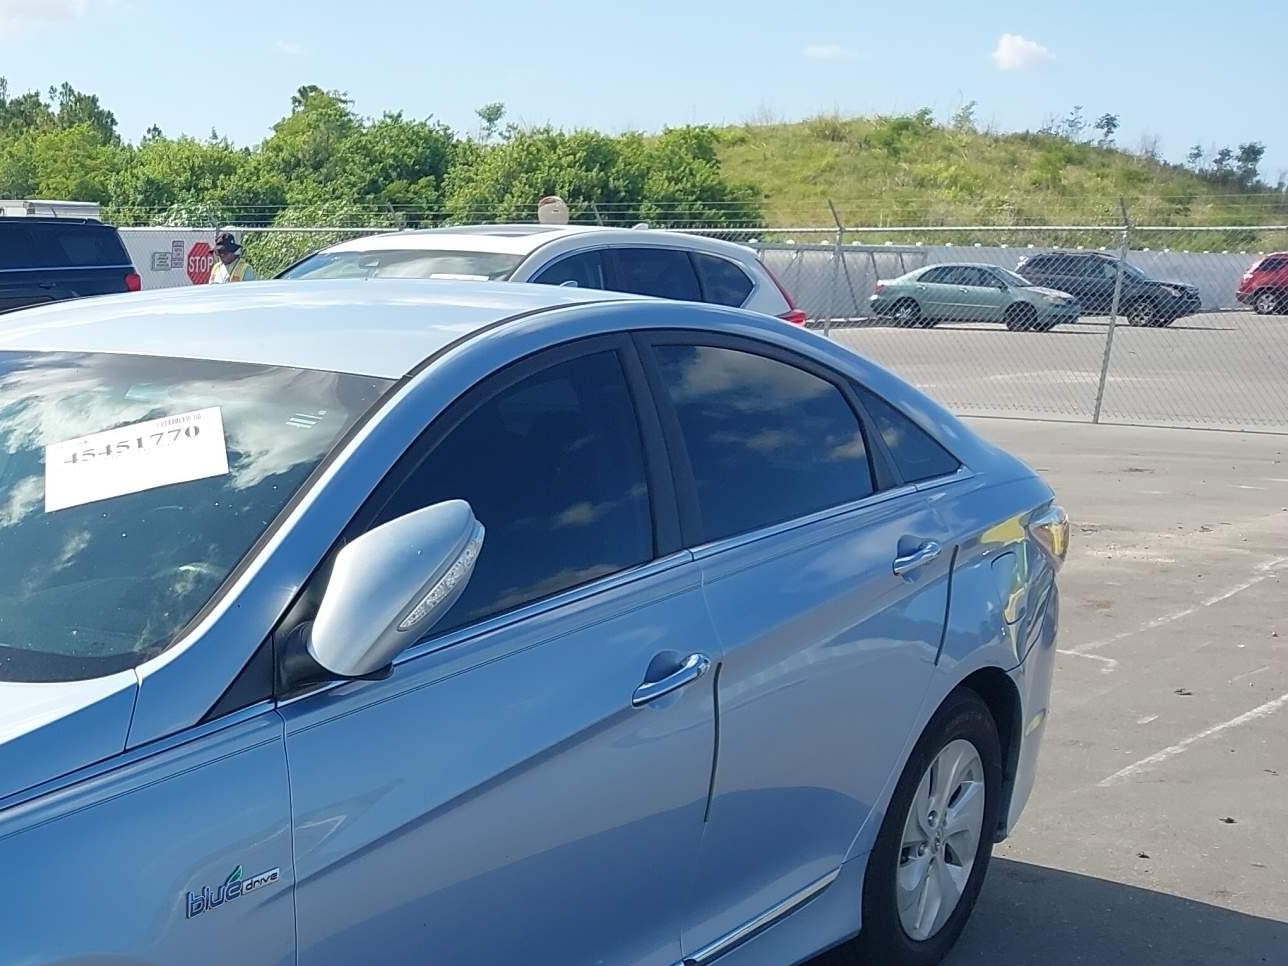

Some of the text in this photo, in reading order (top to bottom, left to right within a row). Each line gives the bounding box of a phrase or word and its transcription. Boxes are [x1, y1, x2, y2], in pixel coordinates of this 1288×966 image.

[188, 257, 214, 273] STOP
[64, 425, 200, 464] 45451770
[186, 871, 279, 919] blue drive
